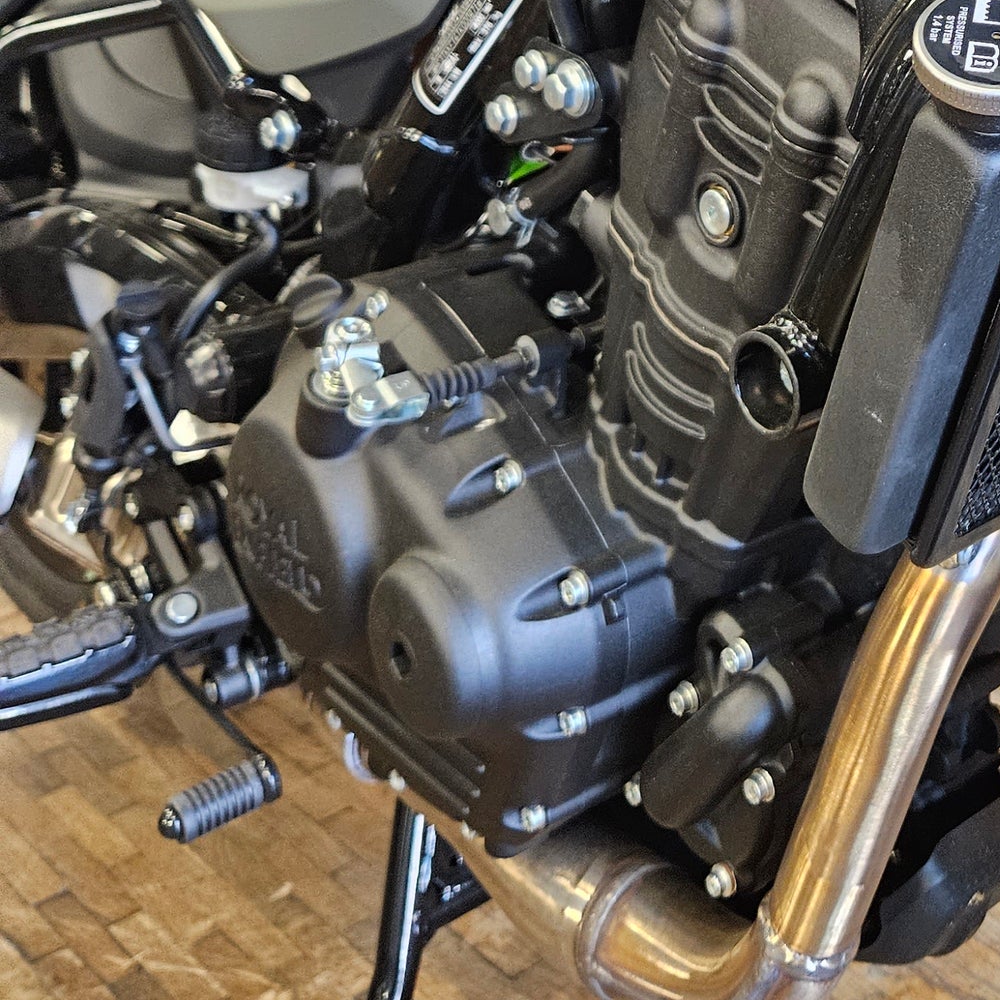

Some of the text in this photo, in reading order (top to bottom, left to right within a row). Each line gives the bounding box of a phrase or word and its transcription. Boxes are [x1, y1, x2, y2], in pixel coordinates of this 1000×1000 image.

[929, 27, 942, 43] bar
[941, 15, 956, 45] SYSTEM
[951, 6, 969, 56] PRESSURISED
